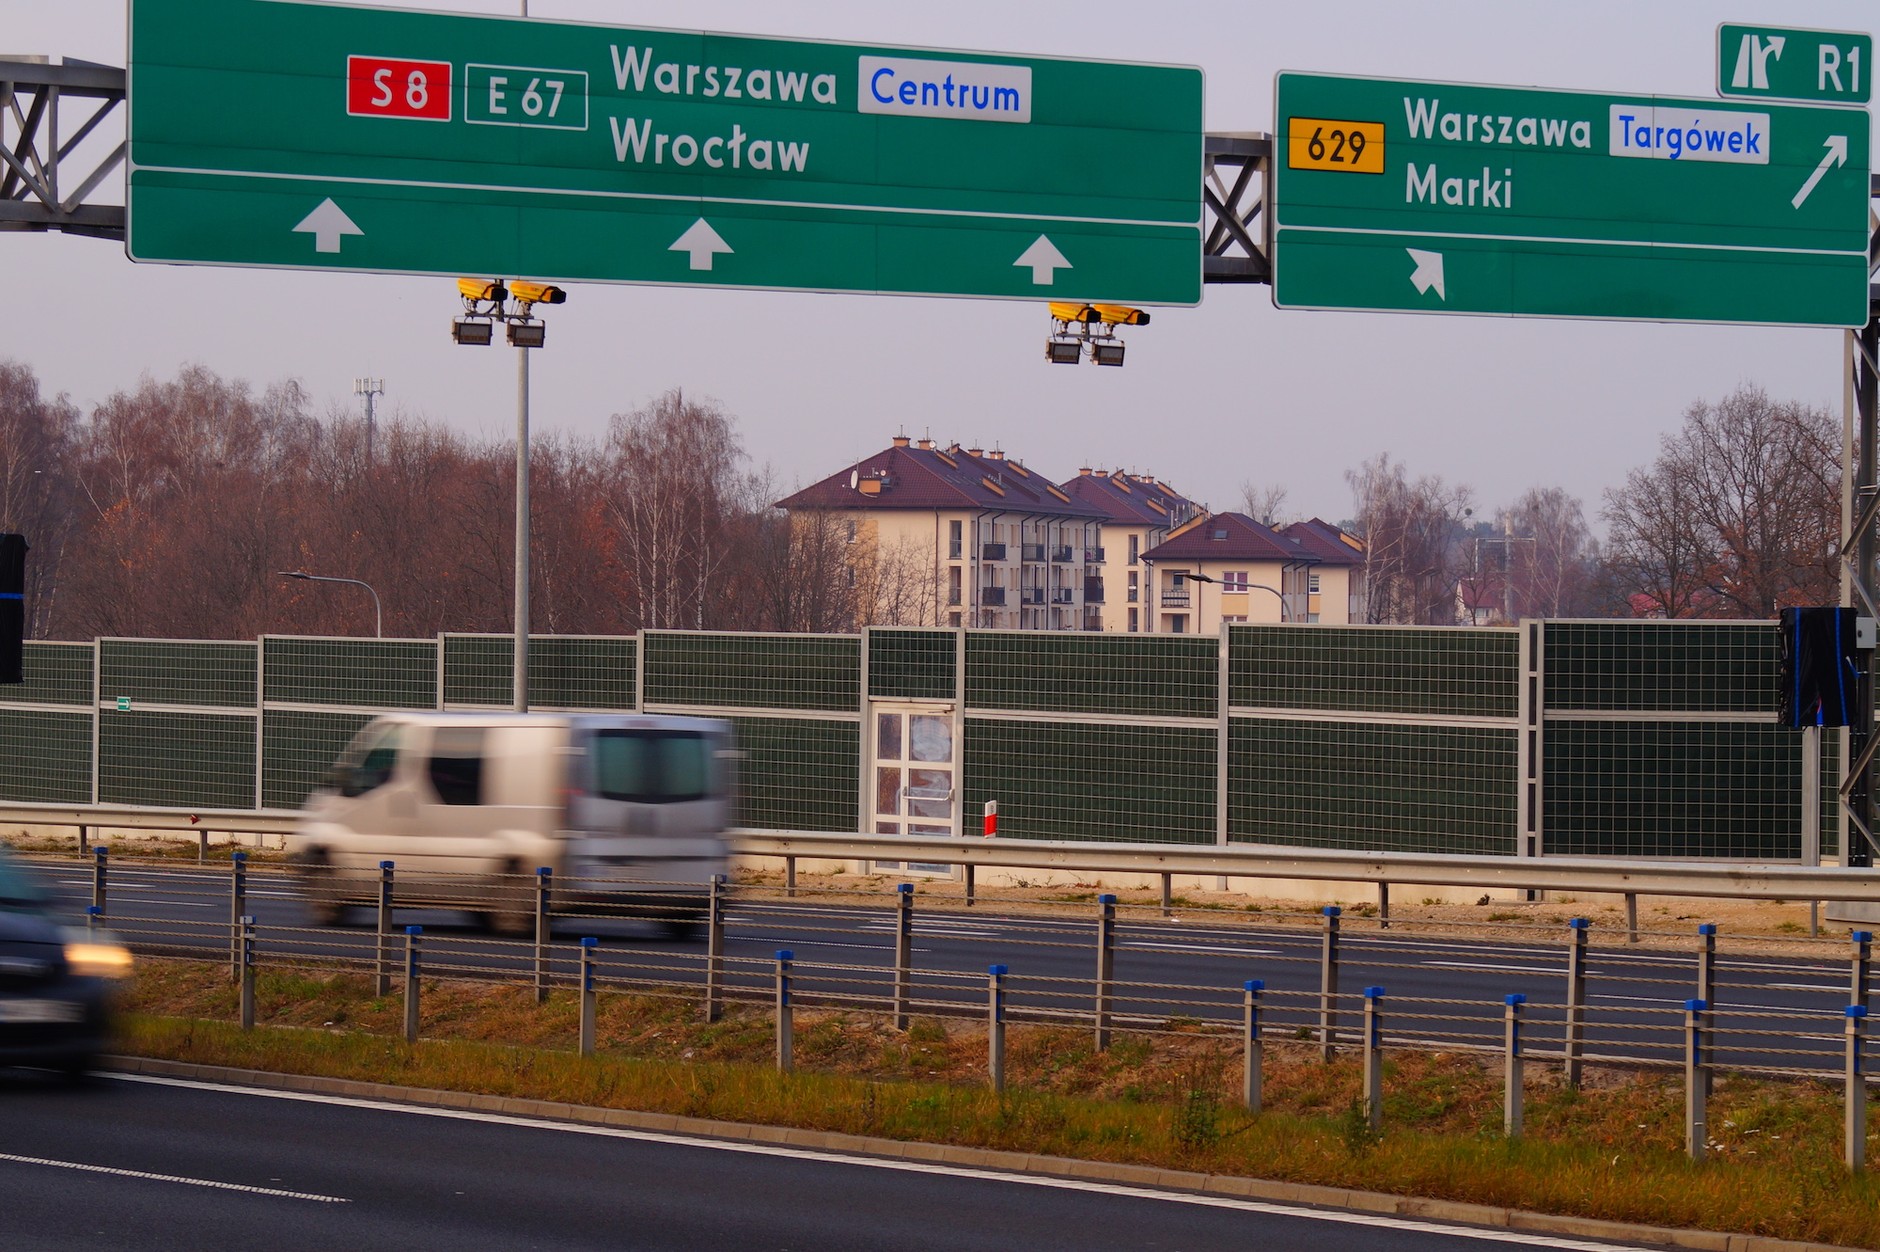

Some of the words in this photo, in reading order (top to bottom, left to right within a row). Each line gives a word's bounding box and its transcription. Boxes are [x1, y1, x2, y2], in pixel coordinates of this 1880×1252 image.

[371, 68, 393, 107] S
[406, 70, 428, 109] 8
[610, 44, 837, 104] Warszawa
[870, 67, 1020, 112] Centrum
[1818, 44, 1860, 93] R1
[489, 76, 508, 114] E
[521, 78, 565, 118] 67
[609, 116, 810, 172] Wrocław
[1403, 97, 1591, 148] Warszawa
[1618, 114, 1761, 161] Targówek
[1308, 127, 1366, 165] 629
[1406, 162, 1512, 208] Marki
